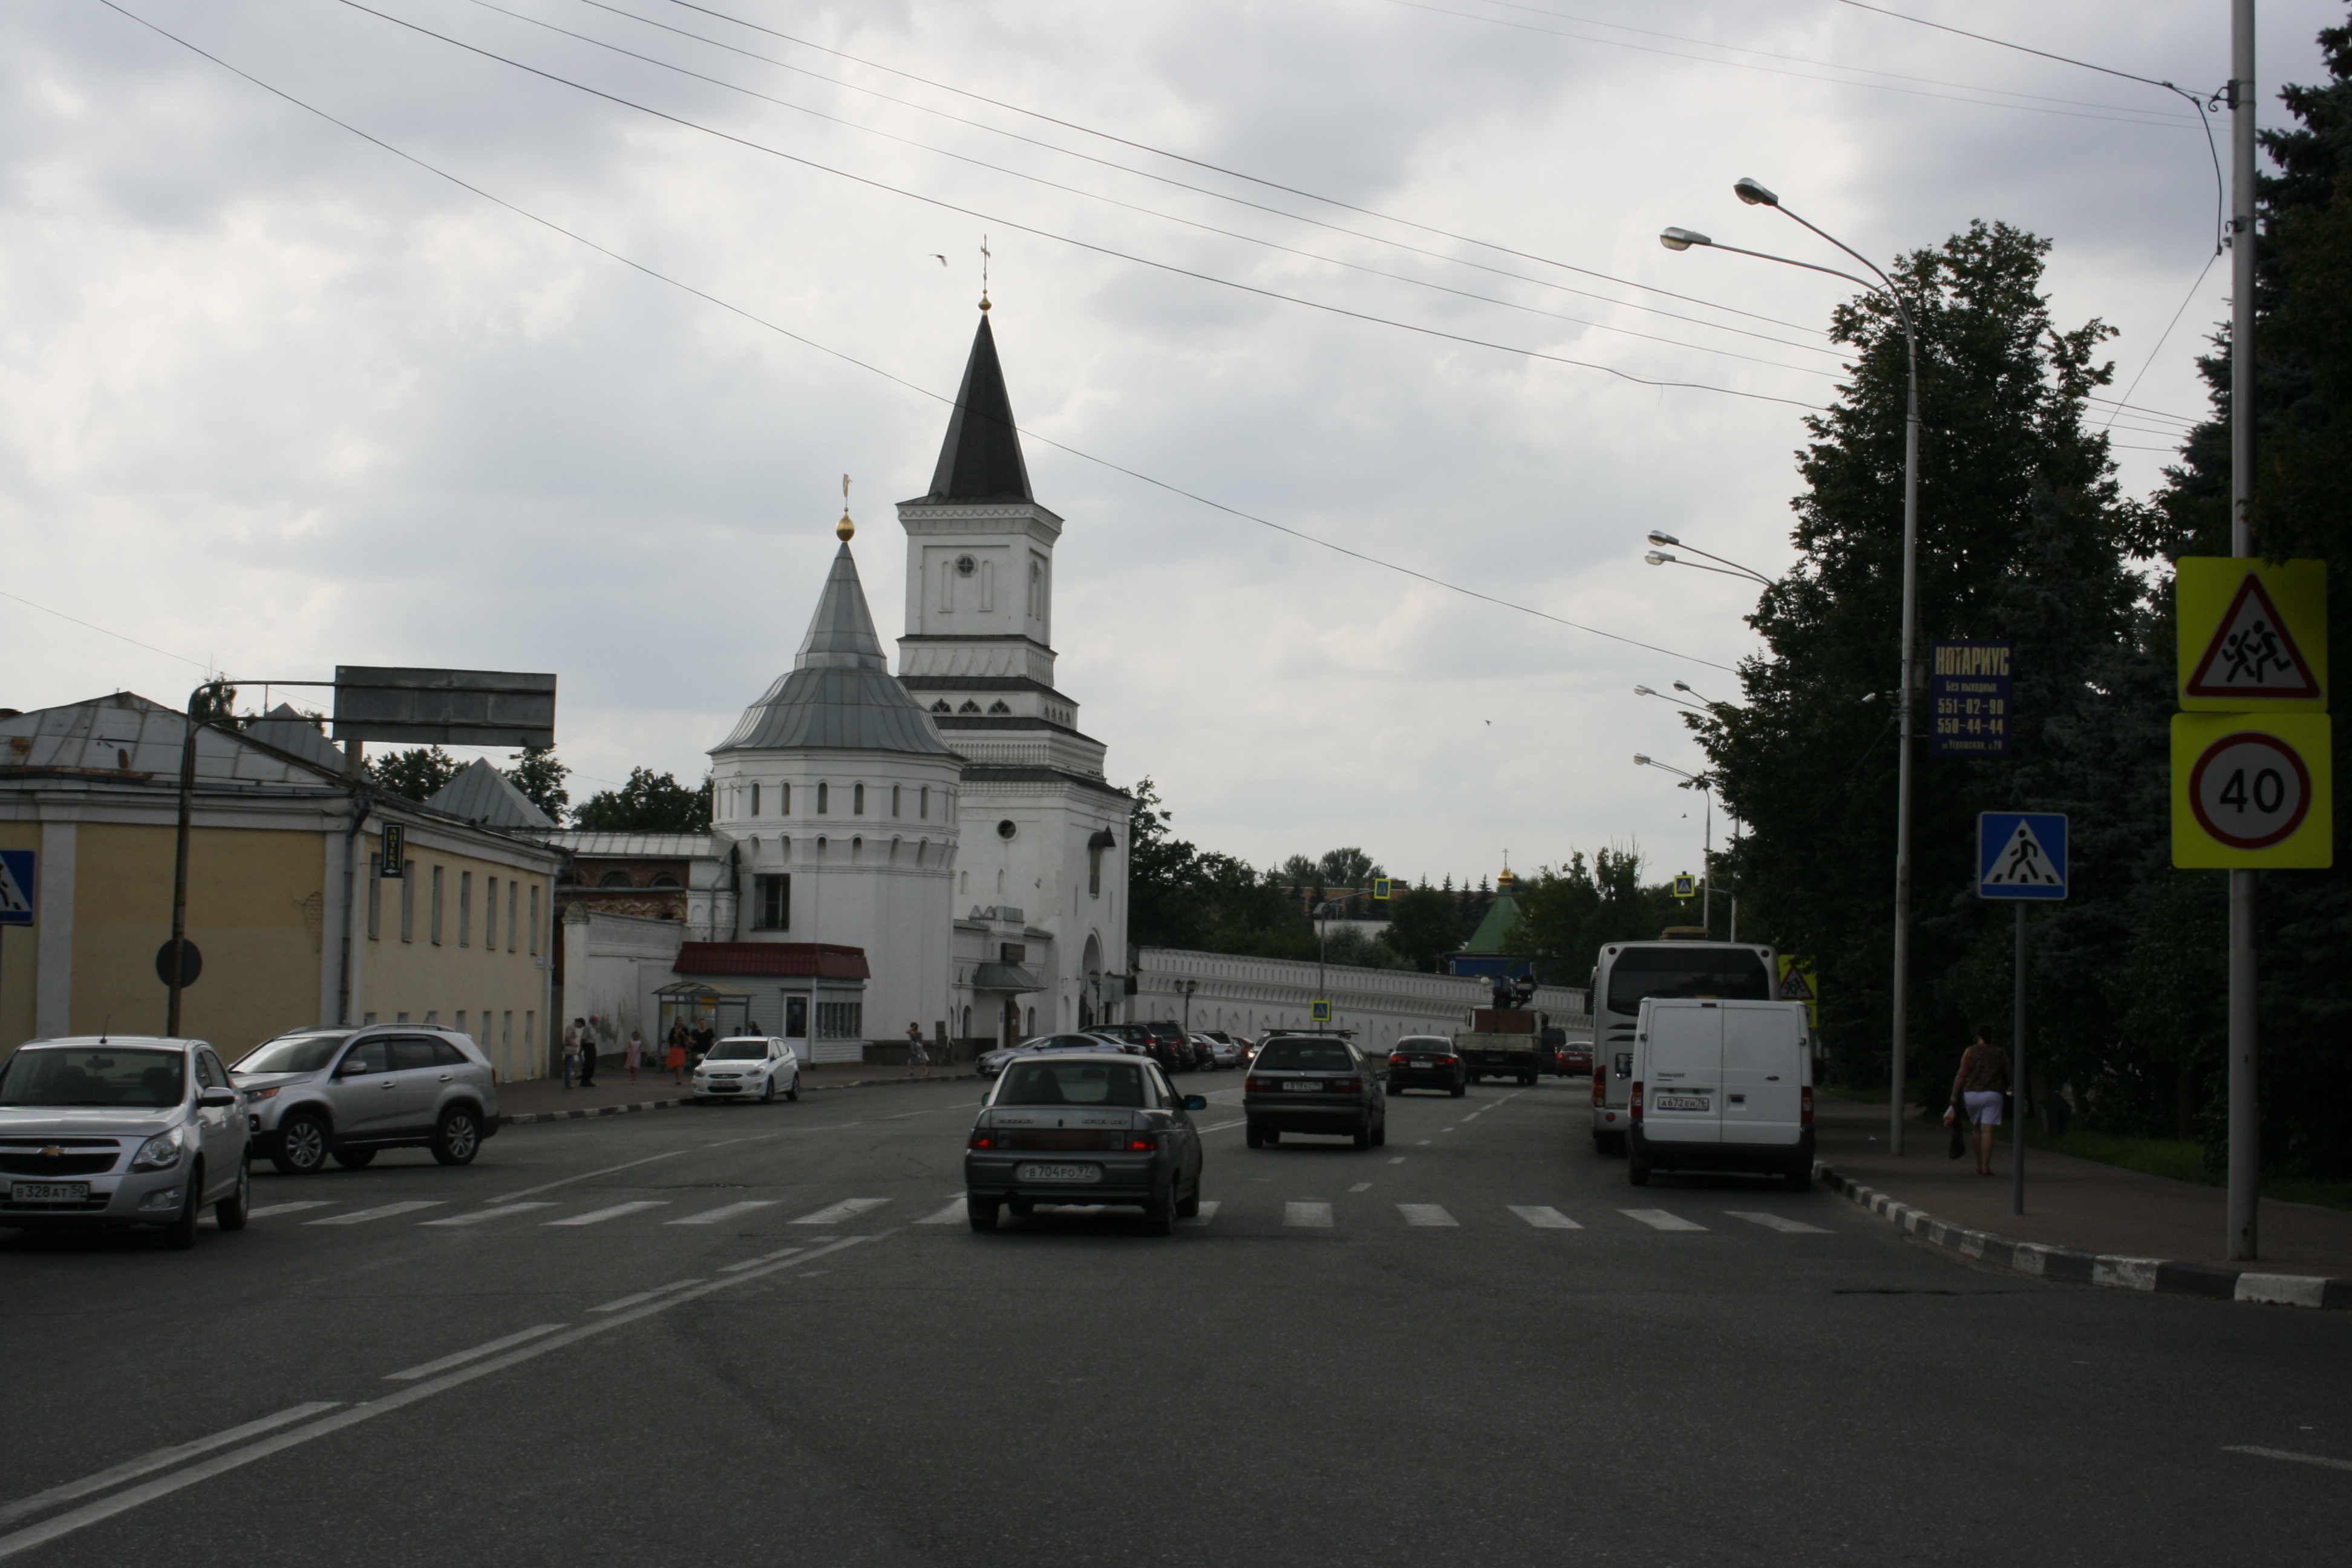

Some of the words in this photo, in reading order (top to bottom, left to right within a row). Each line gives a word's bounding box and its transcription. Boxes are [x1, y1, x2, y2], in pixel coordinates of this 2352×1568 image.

[1935, 647, 2010, 676] НОТАРИУС
[1946, 681, 1959, 691] Без
[1938, 698, 2004, 714] 551-02-90
[1938, 718, 2004, 734] 550-44-44
[2218, 768, 2284, 813] 40
[388, 828, 397, 867] АПТЕКА
